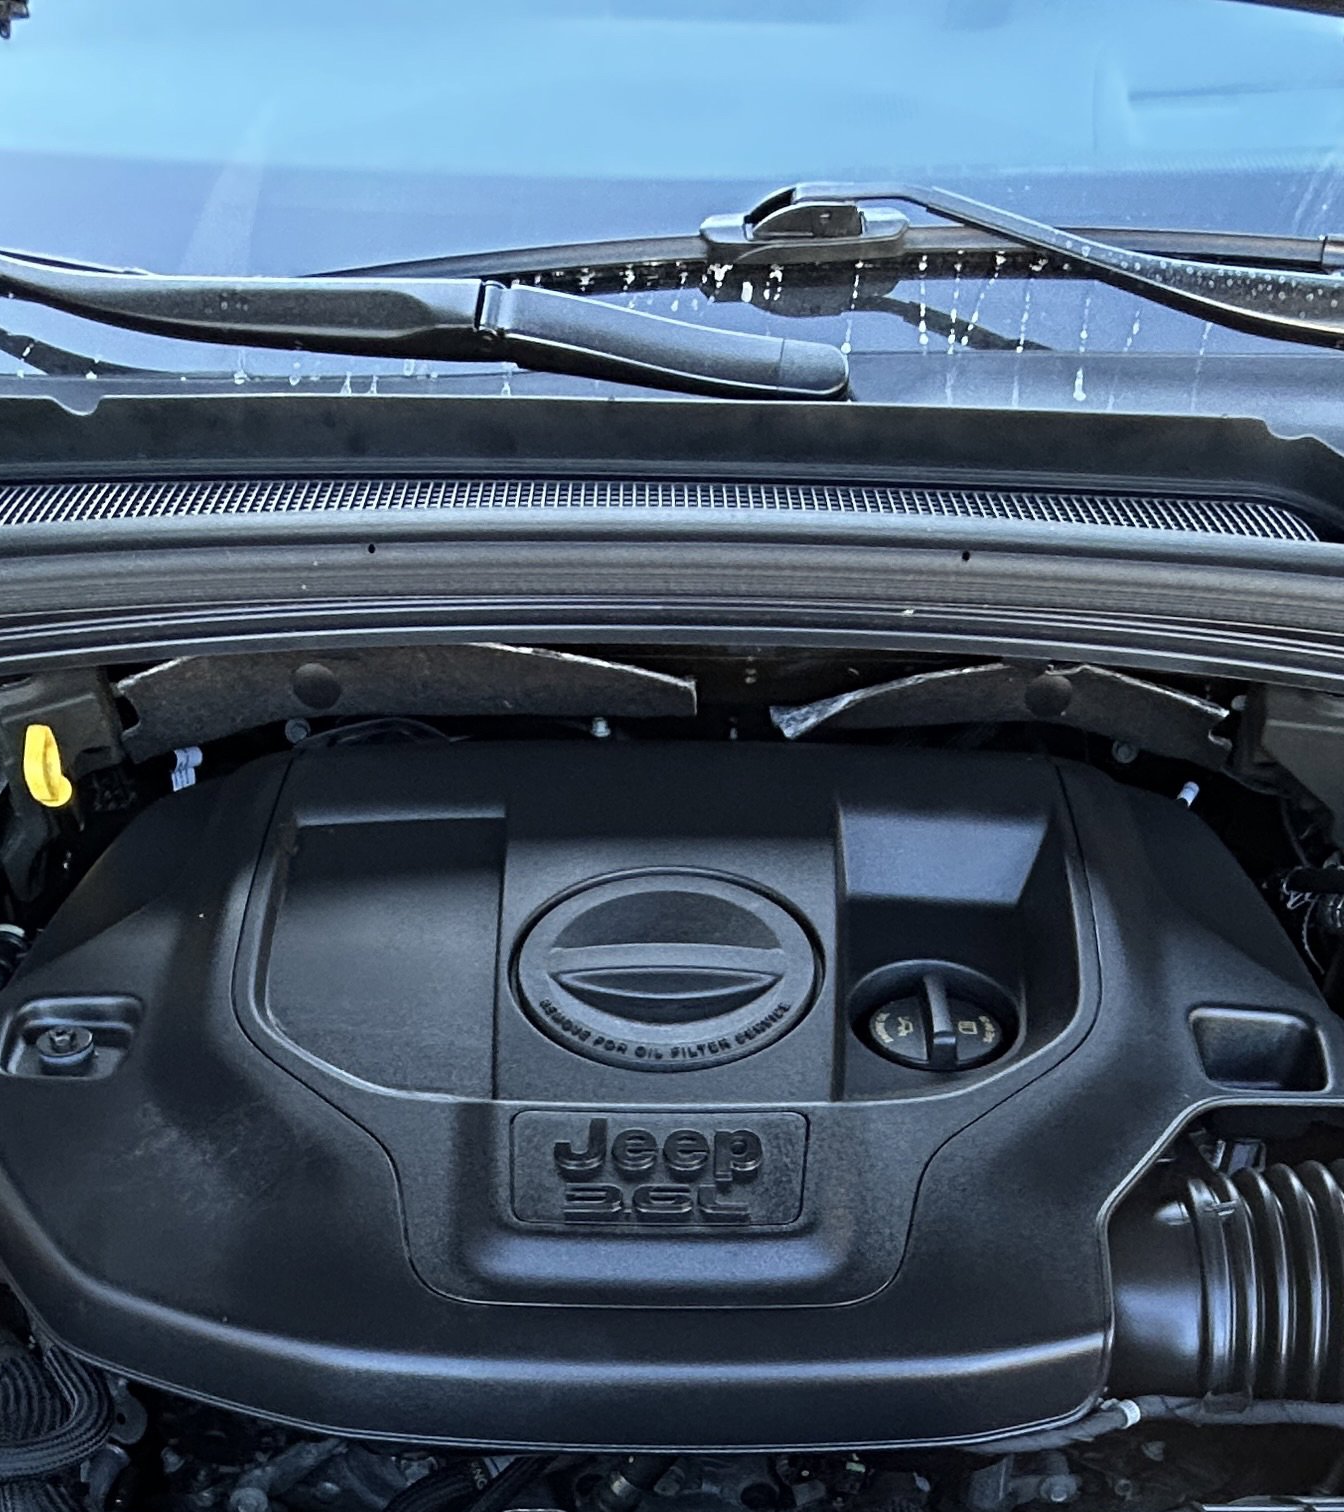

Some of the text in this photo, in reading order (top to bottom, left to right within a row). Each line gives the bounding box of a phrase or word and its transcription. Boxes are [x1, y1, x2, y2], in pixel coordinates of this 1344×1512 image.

[592, 1035, 628, 1056] FOR
[634, 1045, 664, 1060] OIL
[669, 1037, 732, 1060] FILTER
[554, 1117, 763, 1182] Jeep
[564, 1183, 752, 1220] 3.6L
